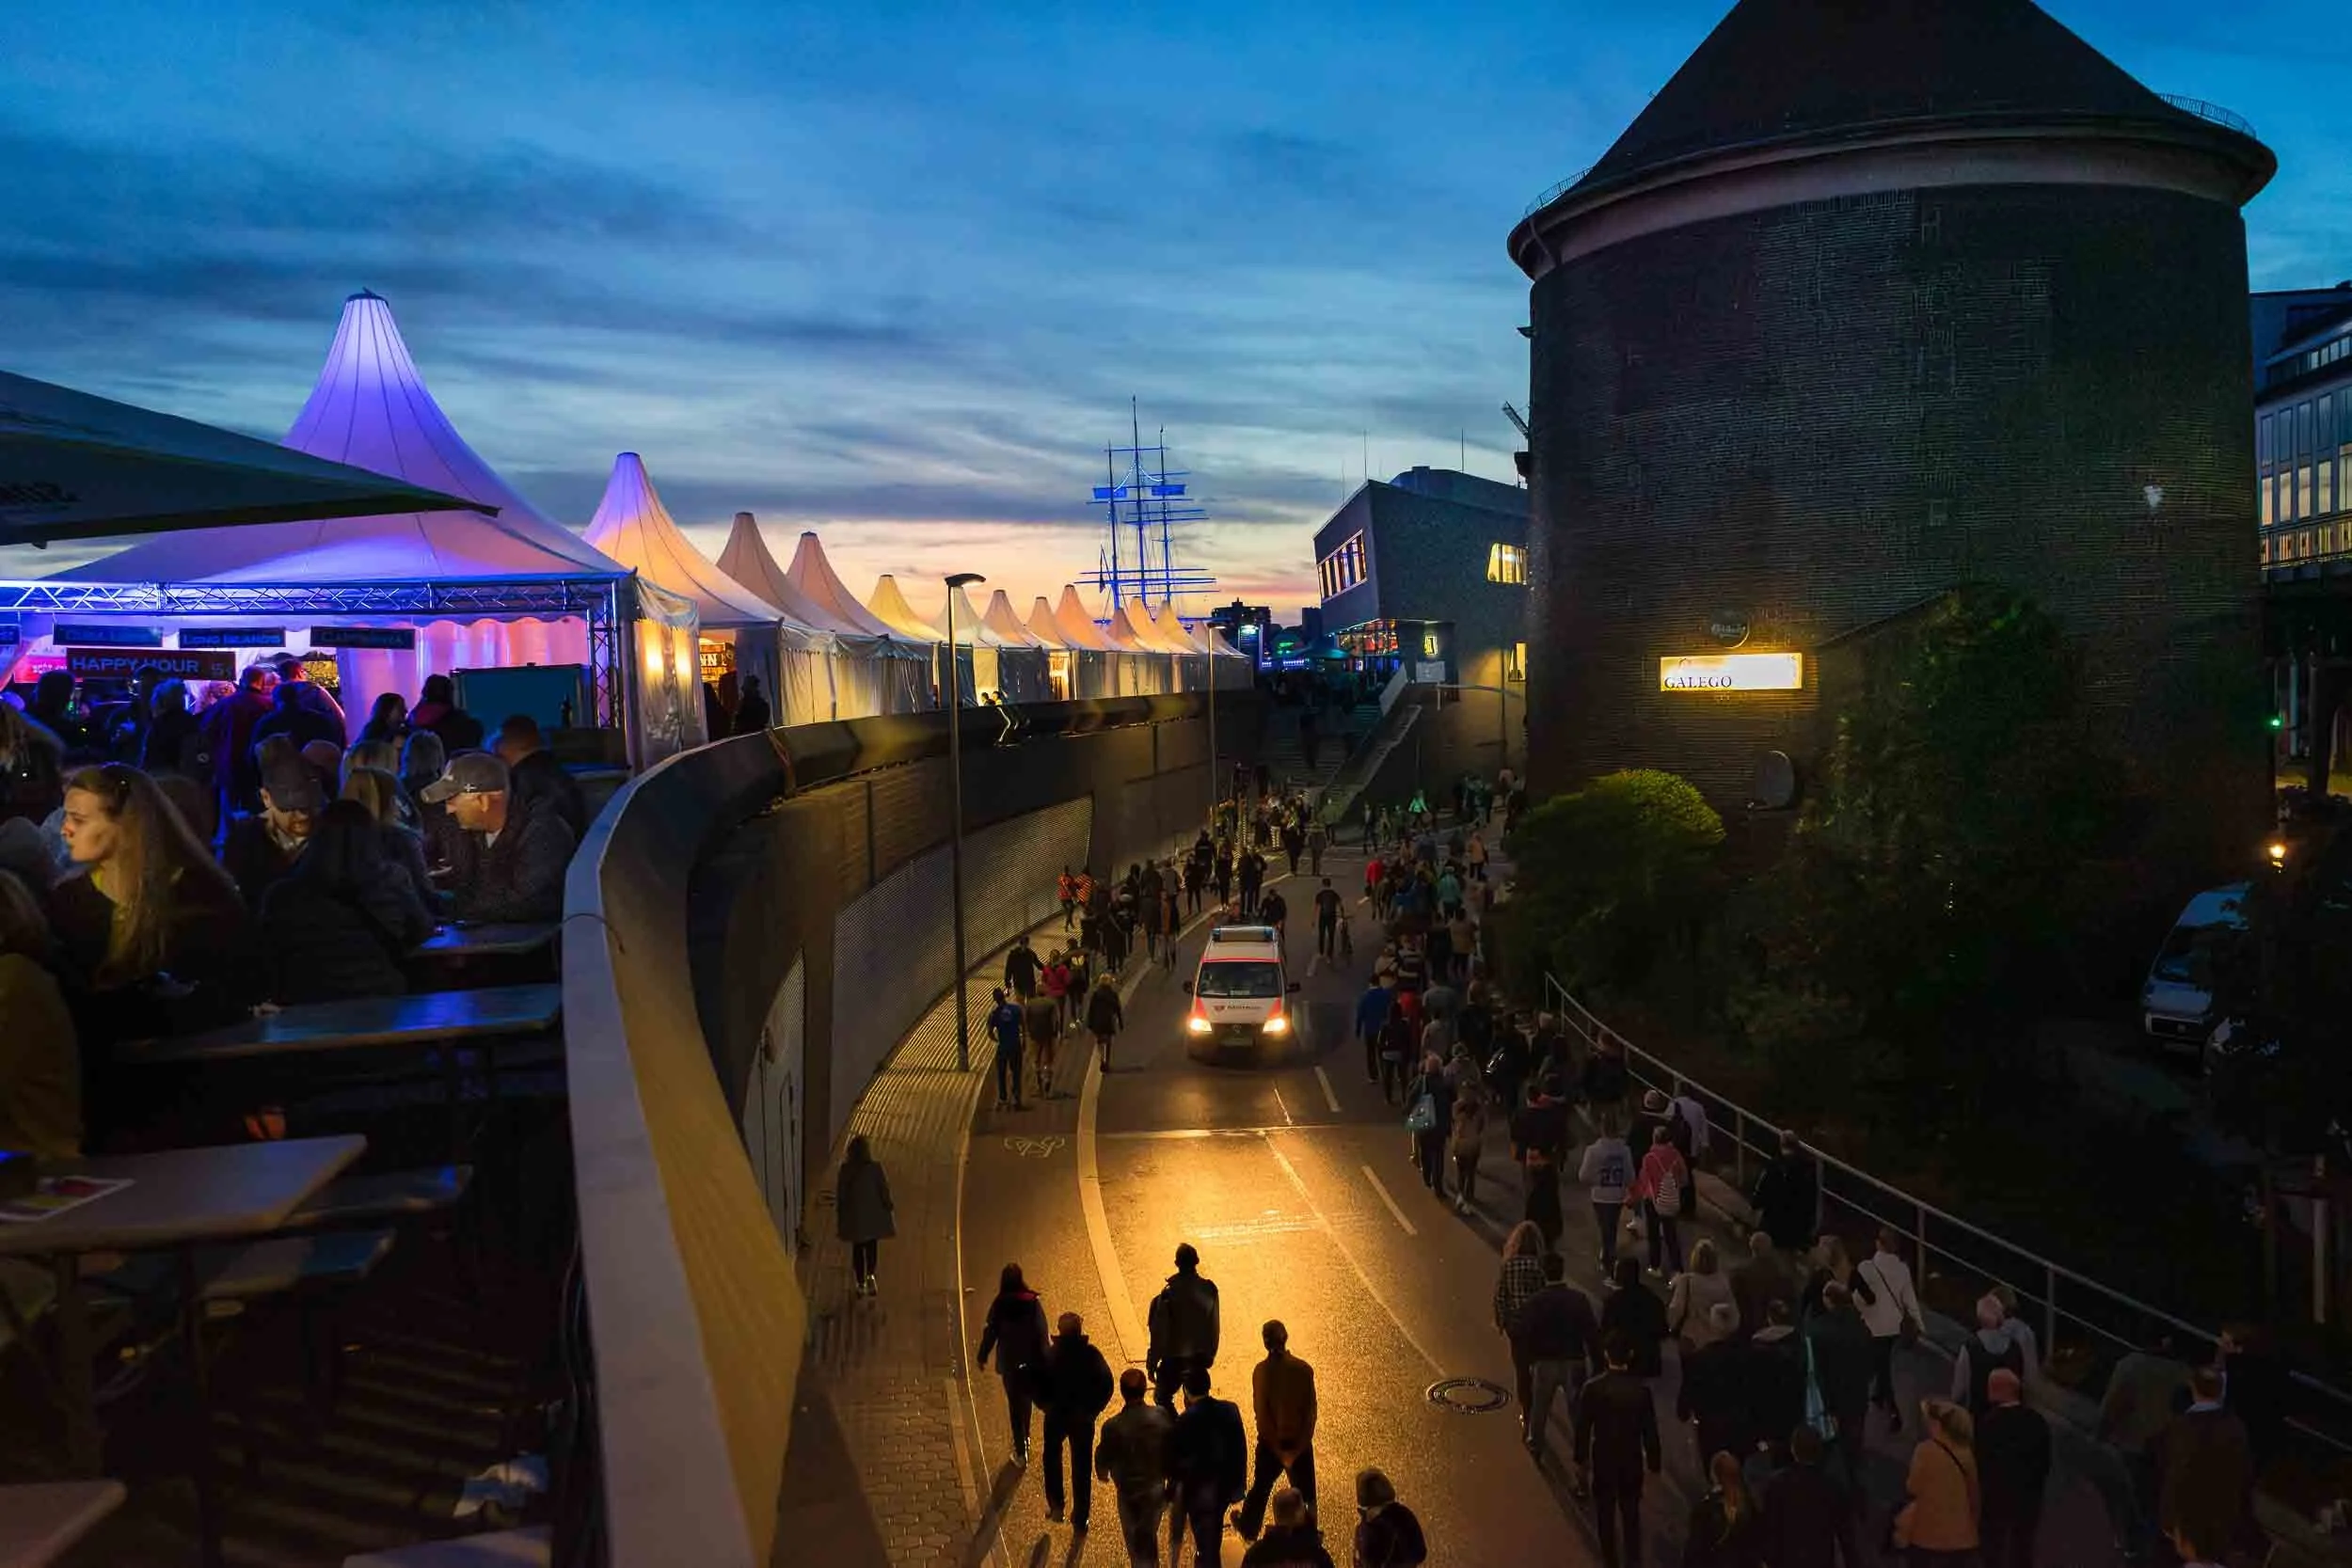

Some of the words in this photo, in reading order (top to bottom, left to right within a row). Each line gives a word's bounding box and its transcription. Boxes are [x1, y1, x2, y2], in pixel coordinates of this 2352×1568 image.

[72, 657, 140, 672] HAPPY
[142, 658, 199, 673] HOUR
[1663, 675, 1733, 689] GALEGO
